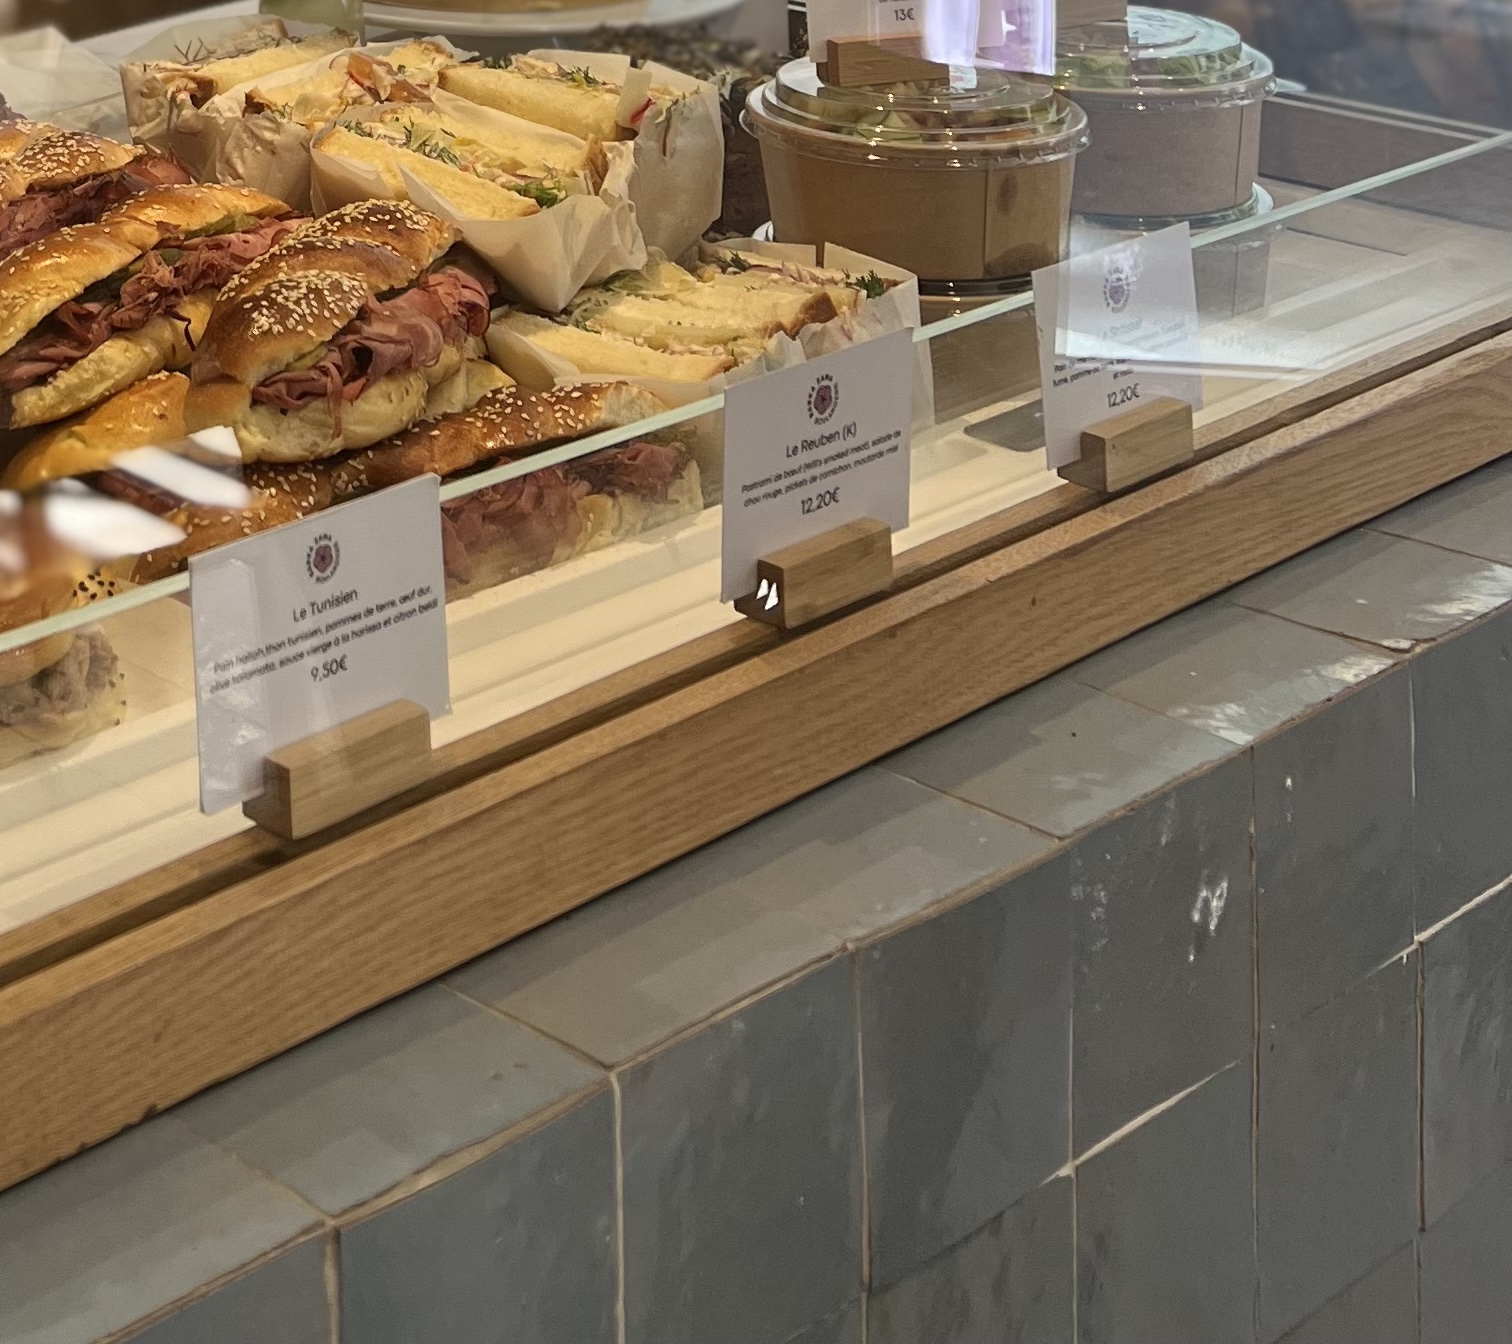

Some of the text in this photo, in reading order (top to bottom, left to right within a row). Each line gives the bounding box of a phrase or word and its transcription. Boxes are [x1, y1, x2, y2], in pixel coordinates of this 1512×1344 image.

[893, 8, 915, 22] 13€
[1107, 383, 1141, 409] 12,20€
[785, 421, 857, 459] Le Reuben (K)
[773, 472, 783, 483] de
[801, 486, 841, 515] 12,20€
[292, 589, 358, 624] Le Tunisien
[213, 659, 234, 674] Pain
[363, 606, 375, 618] de
[341, 632, 350, 644] la
[383, 616, 392, 628] et
[310, 653, 348, 682] 9,50€
